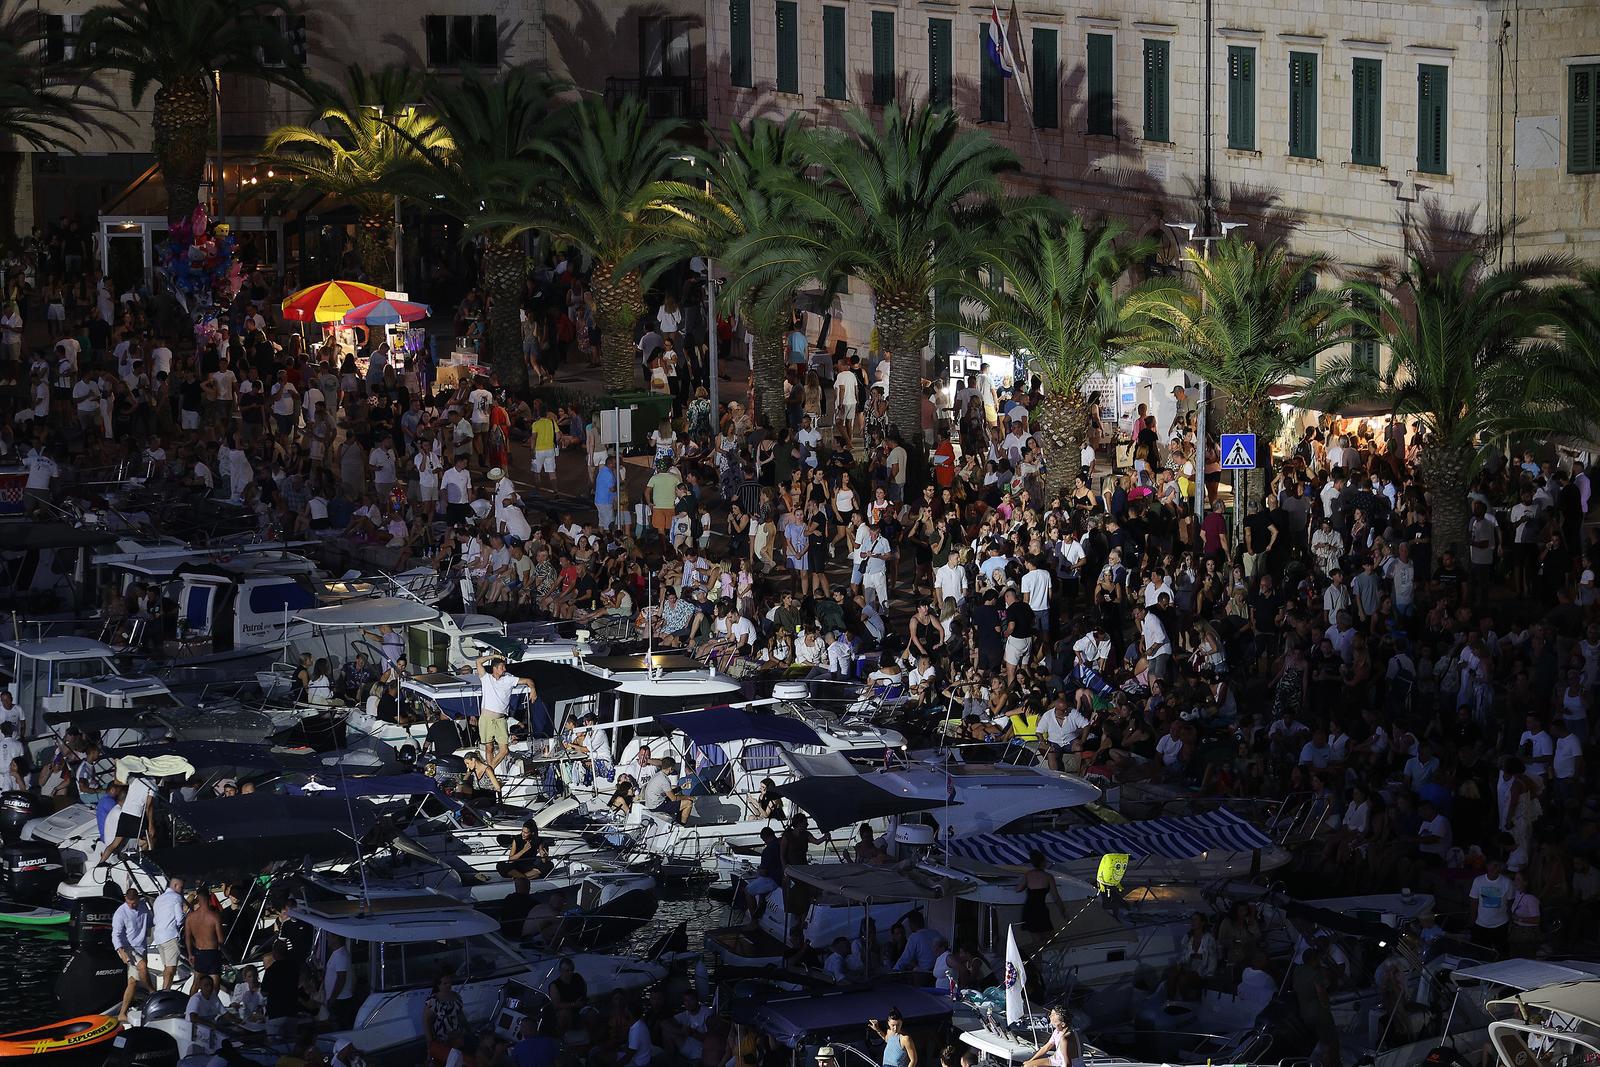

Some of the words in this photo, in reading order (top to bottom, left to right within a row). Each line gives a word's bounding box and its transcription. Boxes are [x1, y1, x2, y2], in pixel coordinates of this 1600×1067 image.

[3, 800, 30, 808] SUZUKI
[18, 858, 47, 867] SUZUKI
[86, 913, 112, 922] SUZU
[68, 1026, 107, 1044] EXPLORER
